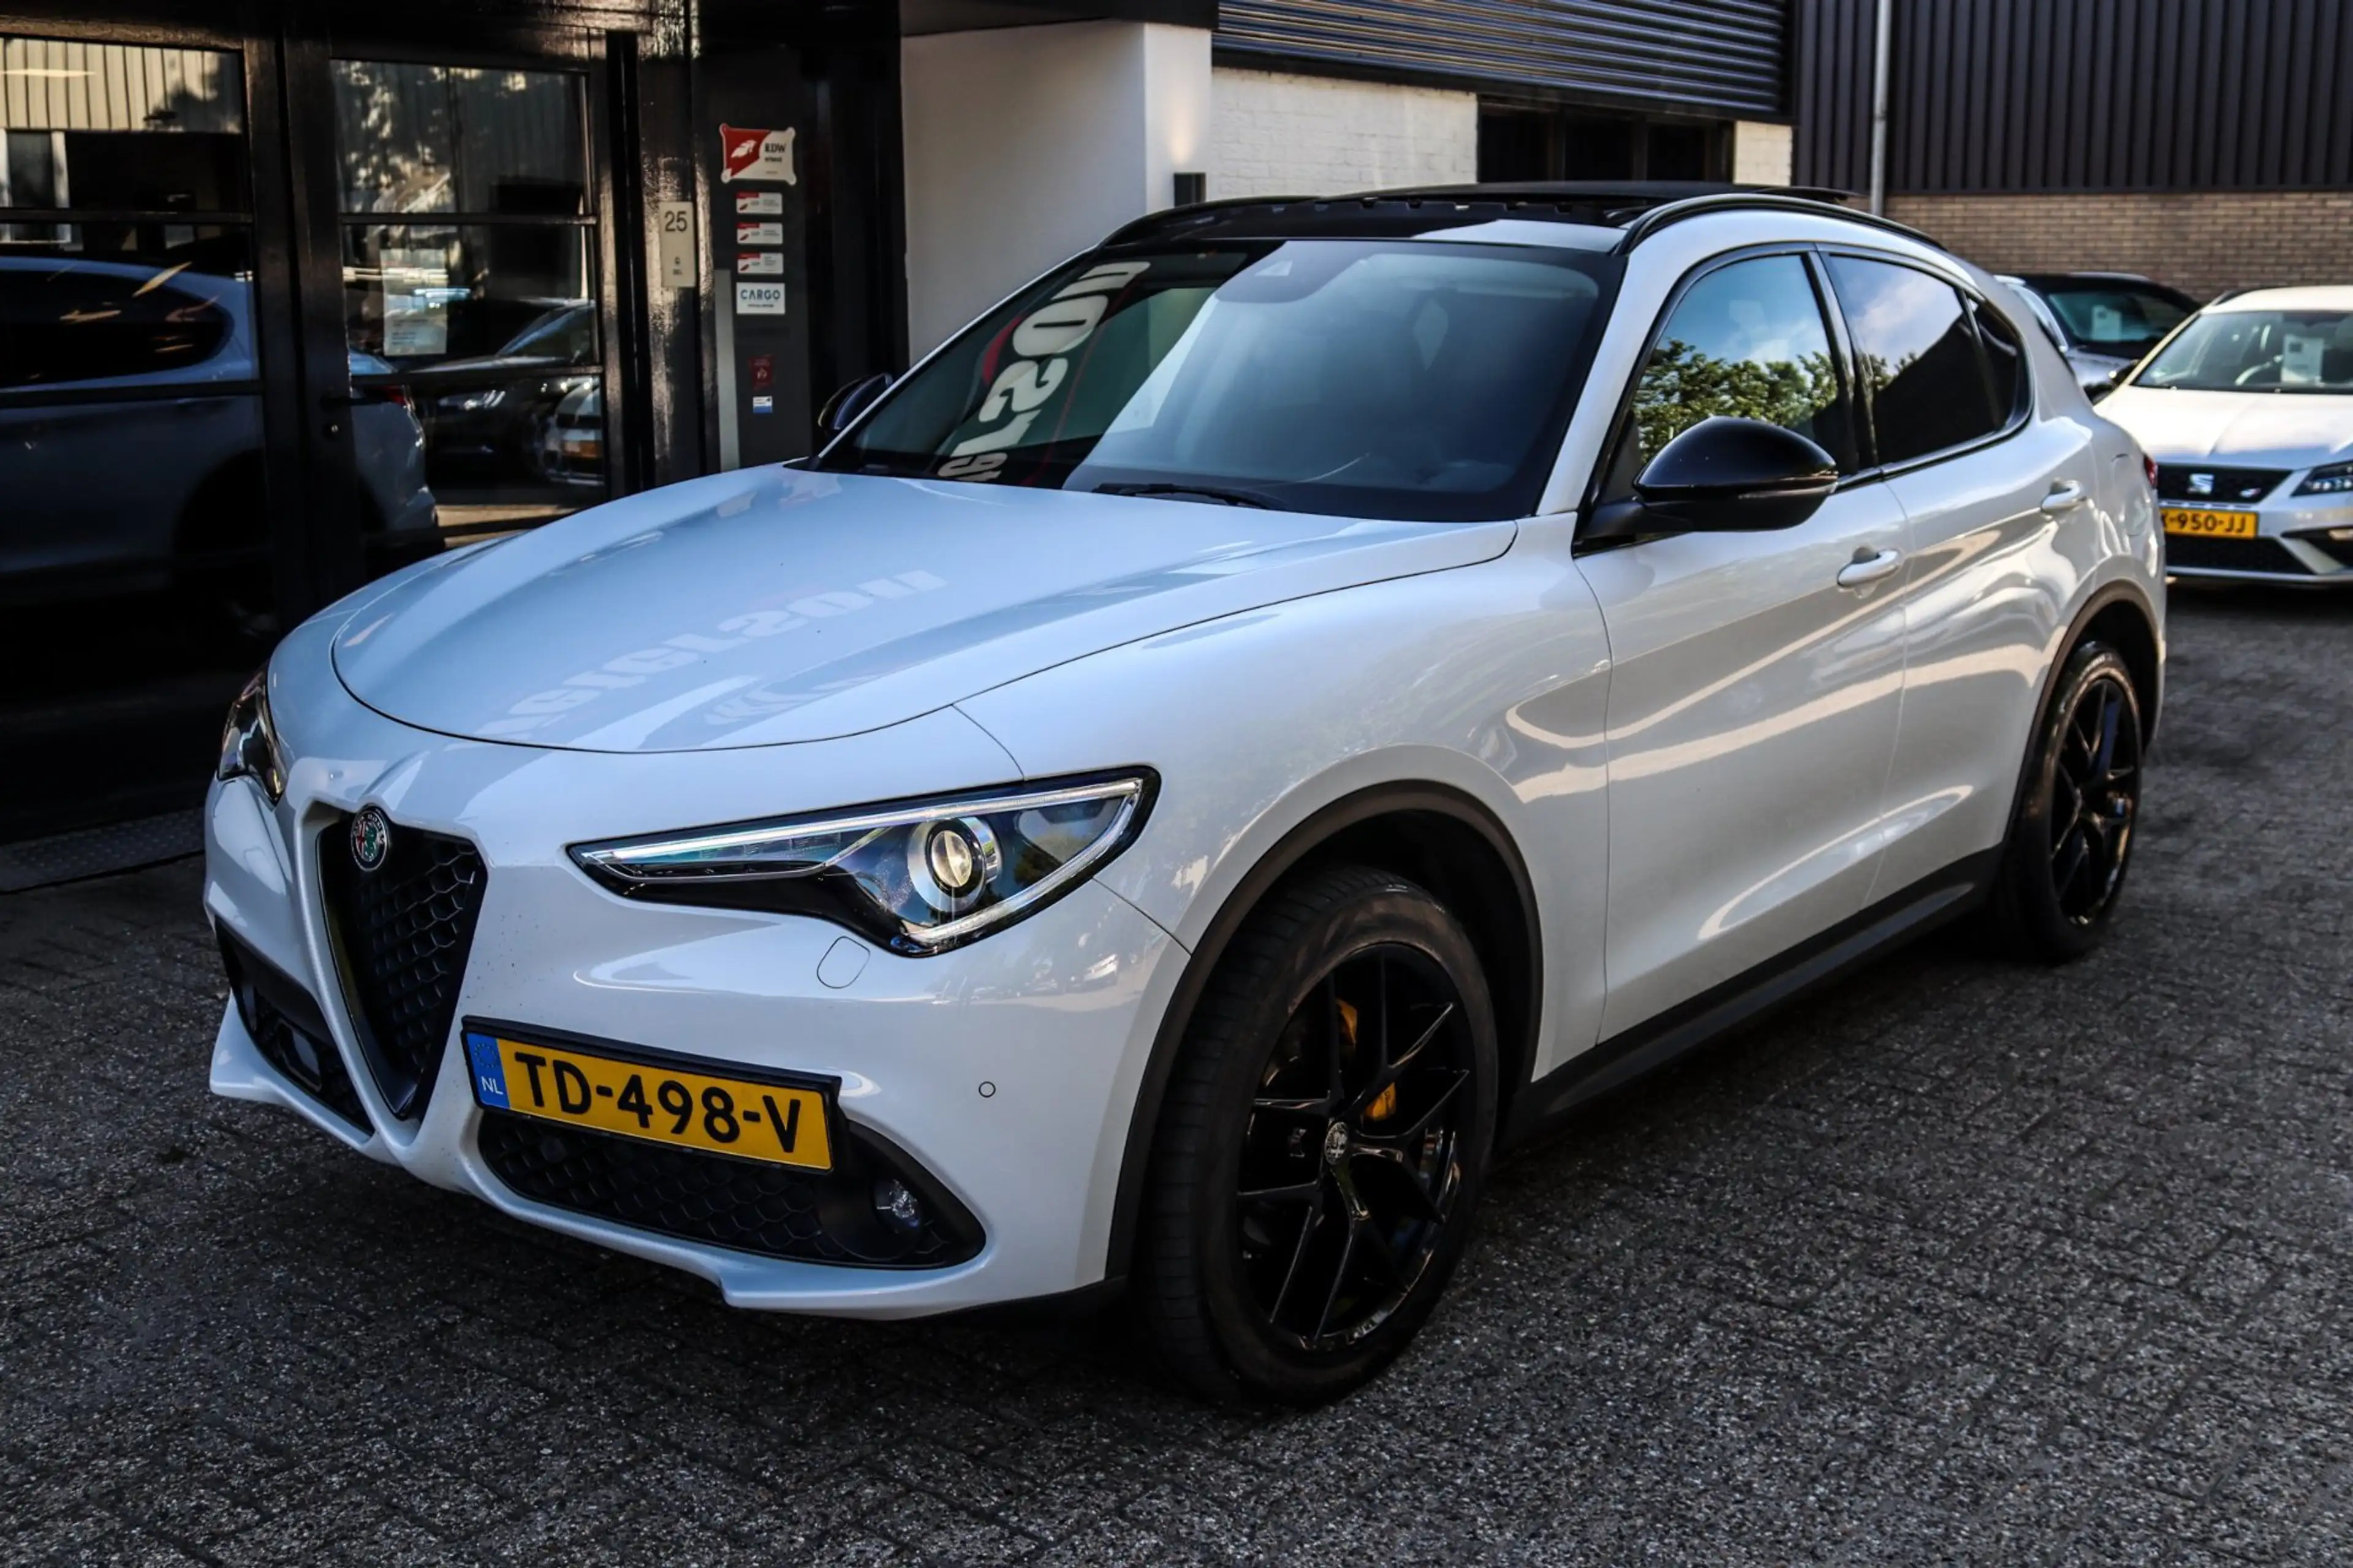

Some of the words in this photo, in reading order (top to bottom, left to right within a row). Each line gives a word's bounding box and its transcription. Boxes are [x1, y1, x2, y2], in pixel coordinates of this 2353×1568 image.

[664, 211, 688, 233] 25
[740, 289, 781, 300] CARGO
[480, 1075, 504, 1097] NL
[513, 1050, 801, 1154] TD-498-V
